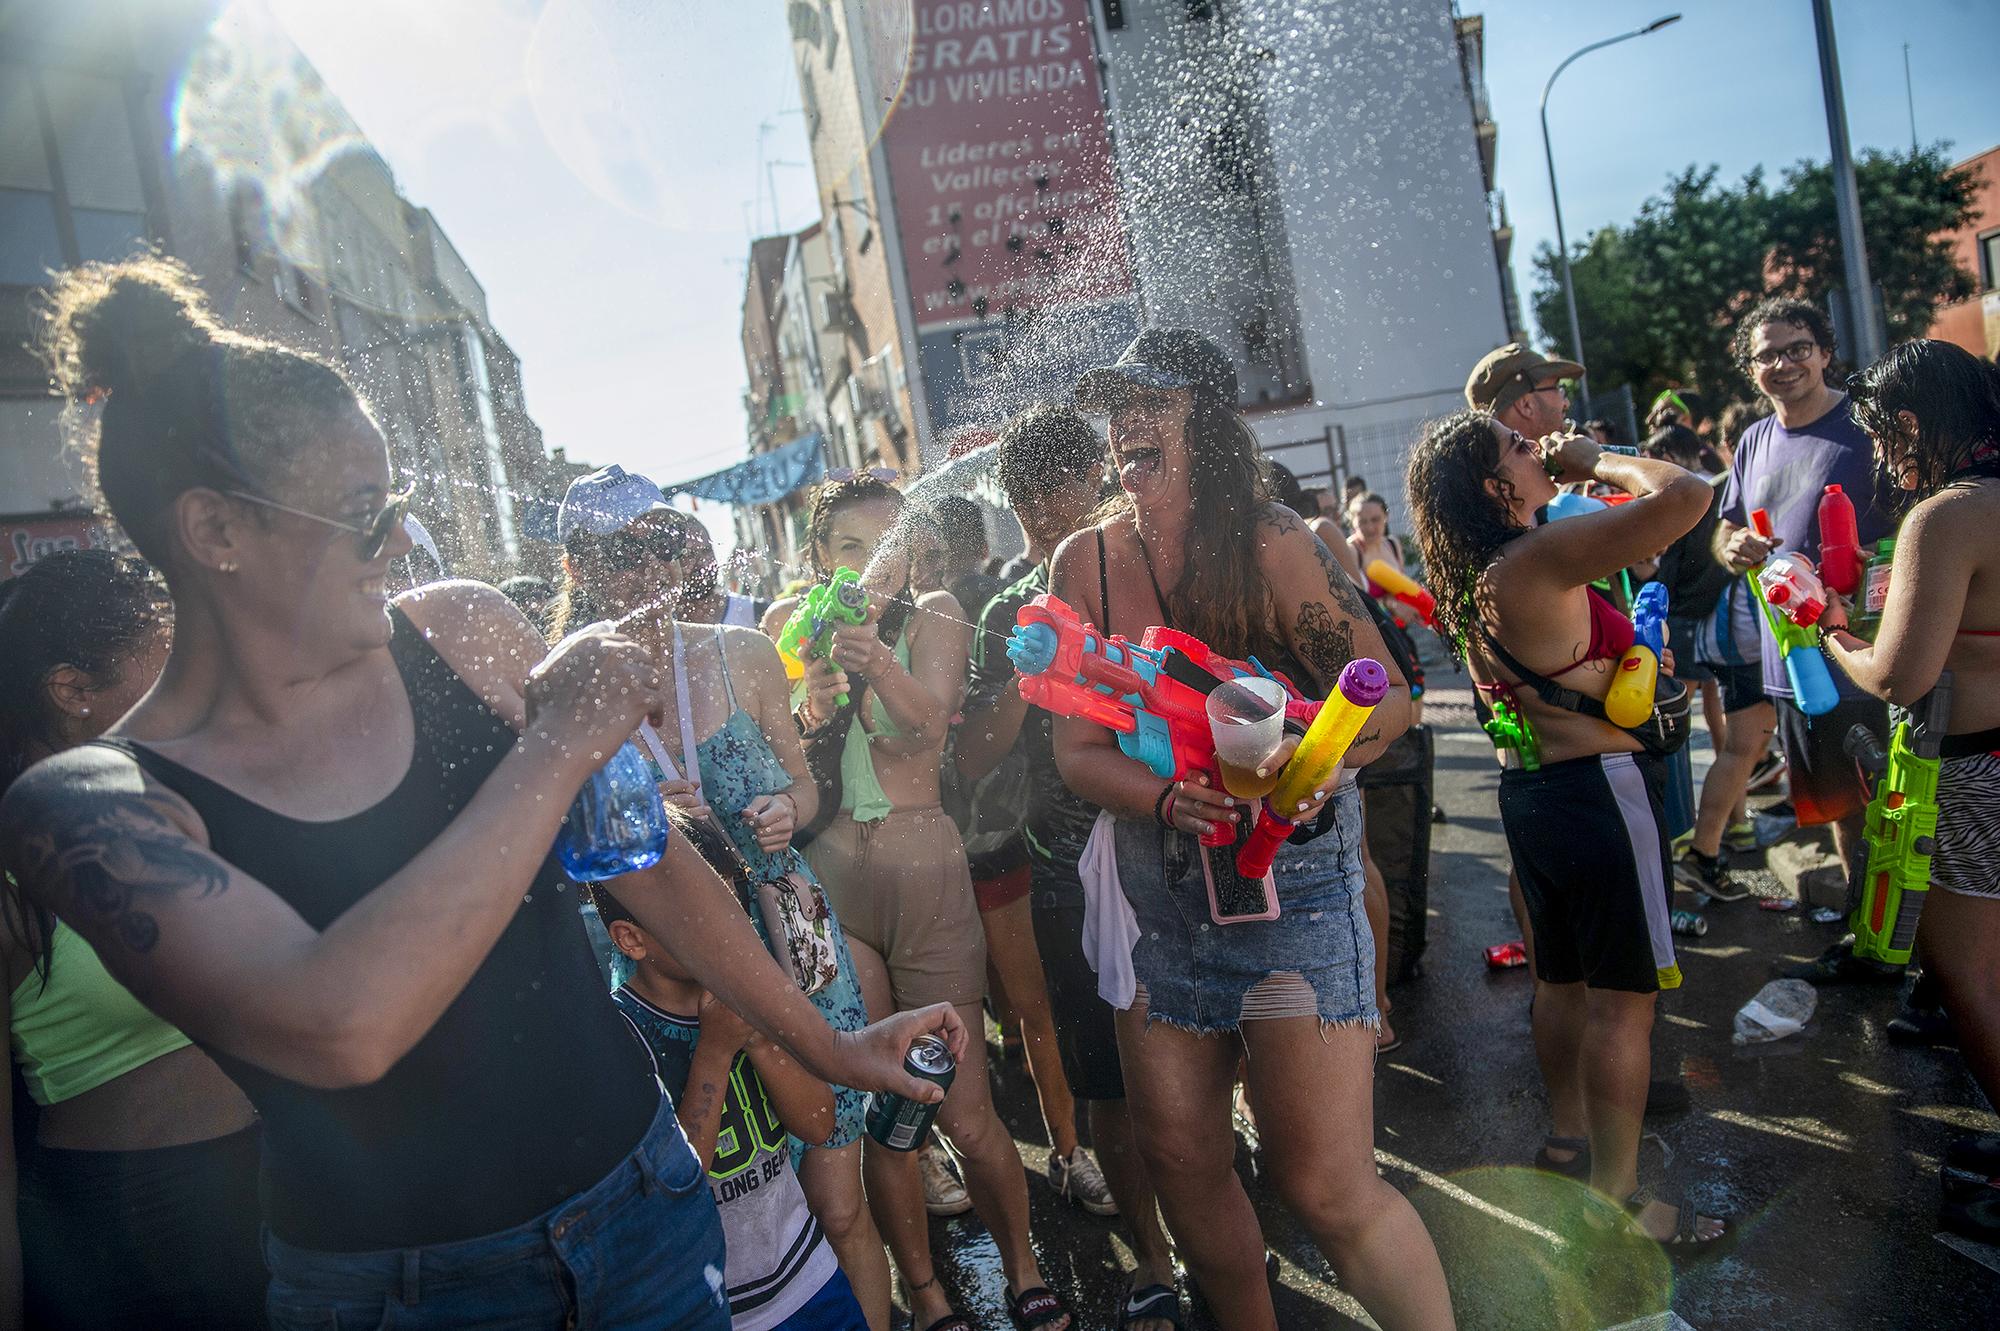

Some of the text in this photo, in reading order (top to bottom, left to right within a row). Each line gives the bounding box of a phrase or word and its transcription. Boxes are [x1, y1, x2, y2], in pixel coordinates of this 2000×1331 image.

[919, 0, 1064, 35] LORAMOS
[910, 26, 1072, 74] GRATIS
[945, 60, 1085, 102] VIVIENDA
[932, 160, 1062, 193] Vallecas
[710, 1168, 760, 1206] LONG
